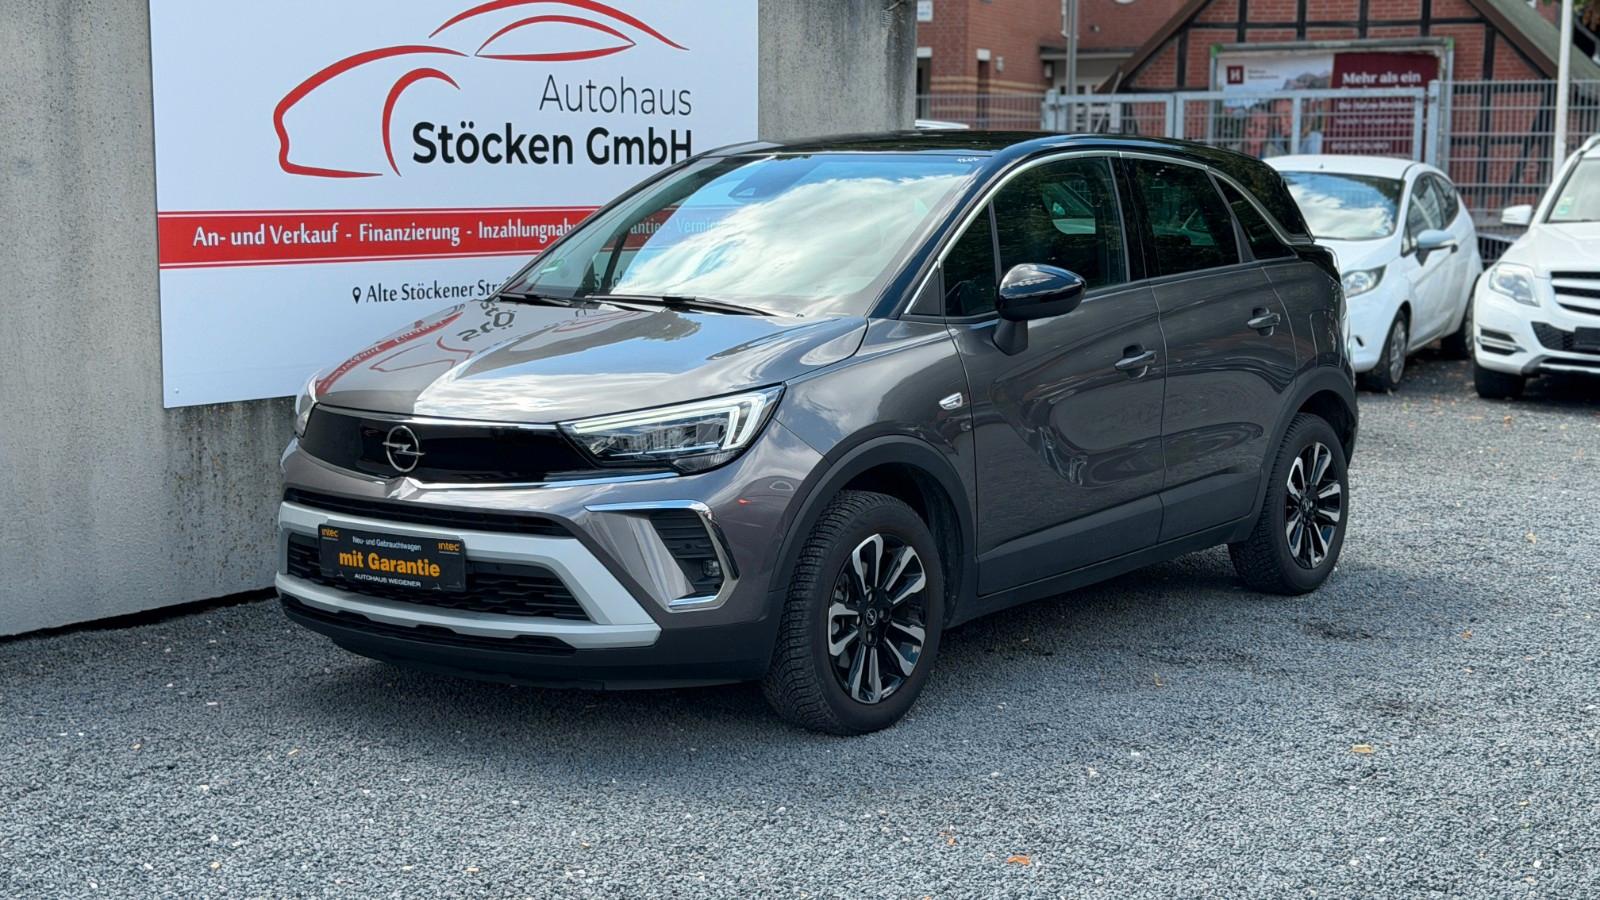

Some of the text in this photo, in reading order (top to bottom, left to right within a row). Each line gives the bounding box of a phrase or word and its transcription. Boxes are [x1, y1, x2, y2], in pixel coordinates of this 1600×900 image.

[1342, 69, 1422, 85] Mehr als ein
[539, 74, 692, 116] Autohaus
[412, 121, 692, 165] Stöcken GmbH
[192, 226, 226, 247] An-
[231, 223, 265, 246] und
[269, 222, 339, 245] Verkauf
[359, 222, 461, 247] Finanzierung
[478, 217, 577, 245] Inzahlungnah
[366, 276, 511, 303] Alte Stöckener Str
[365, 538, 376, 546] und
[376, 539, 422, 552] Gebrauchtwagen
[338, 549, 441, 578] mit Garantie
[354, 573, 422, 588] AUTOHAUS WEGENER
